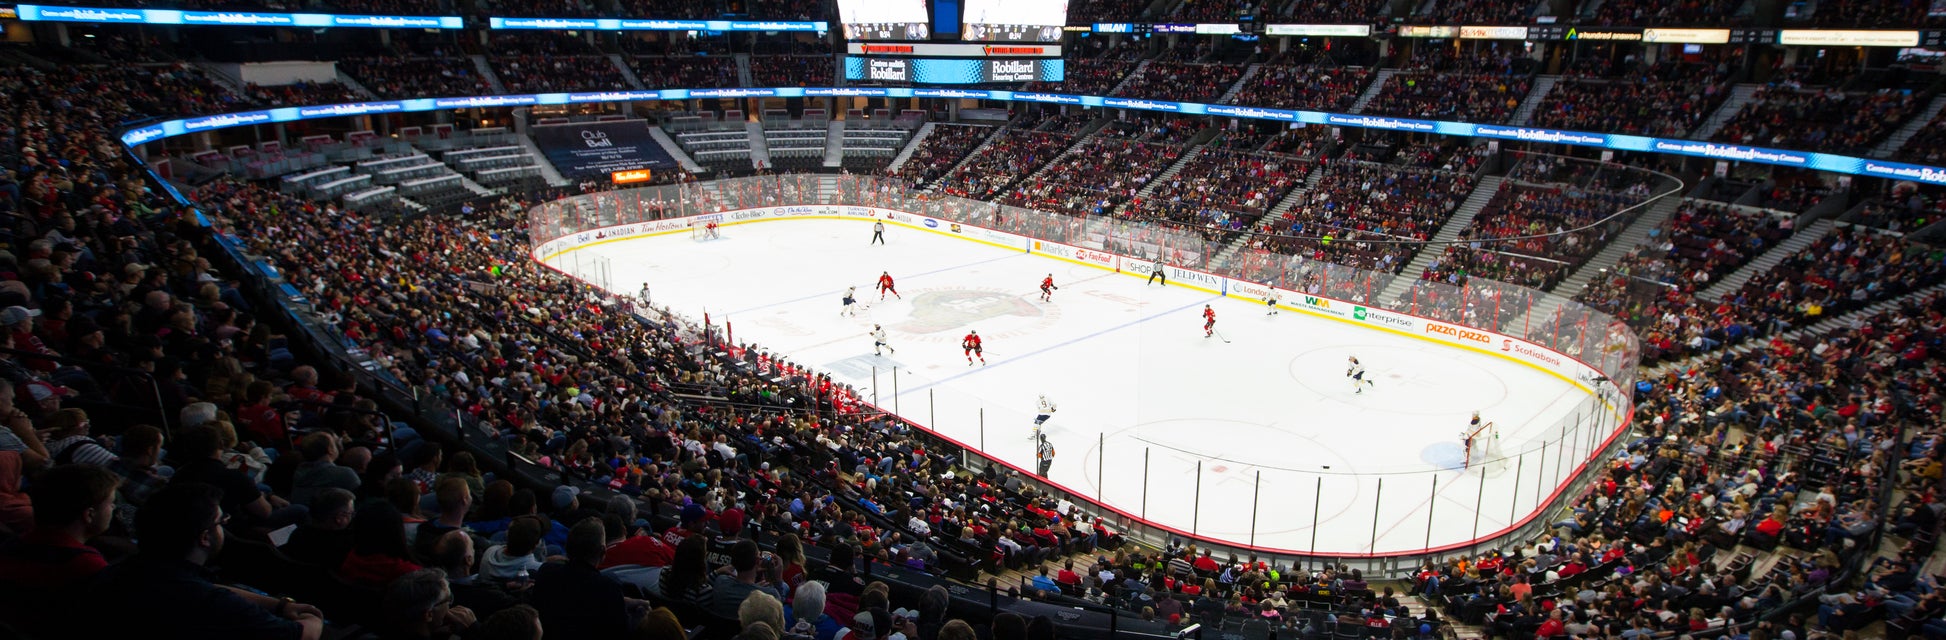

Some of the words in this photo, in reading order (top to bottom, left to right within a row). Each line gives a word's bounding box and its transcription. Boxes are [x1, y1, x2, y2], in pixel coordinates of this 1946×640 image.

[870, 66, 906, 80] Robillard
[992, 60, 1034, 74] Robillard
[992, 73, 1014, 82] Hearing
[1013, 72, 1034, 81] Centres
[1127, 100, 1153, 109] Robillard
[1235, 107, 1265, 118] Robillard
[1362, 117, 1397, 129] Robillard
[580, 129, 607, 141] Club
[1517, 128, 1560, 142] Robillard
[585, 137, 613, 149] Bell
[1705, 143, 1755, 160] Robillard
[604, 226, 636, 239] CANADIAN
[640, 223, 654, 233] Tim
[655, 221, 684, 232] Hortons
[577, 233, 590, 245] Bell
[1041, 241, 1070, 258] Mark's
[1130, 262, 1152, 276] SHOP
[1304, 295, 1330, 309] WM
[1426, 322, 1457, 337] pizza
[1458, 331, 1491, 345] pizza
[1514, 343, 1562, 367] Scotiabank
